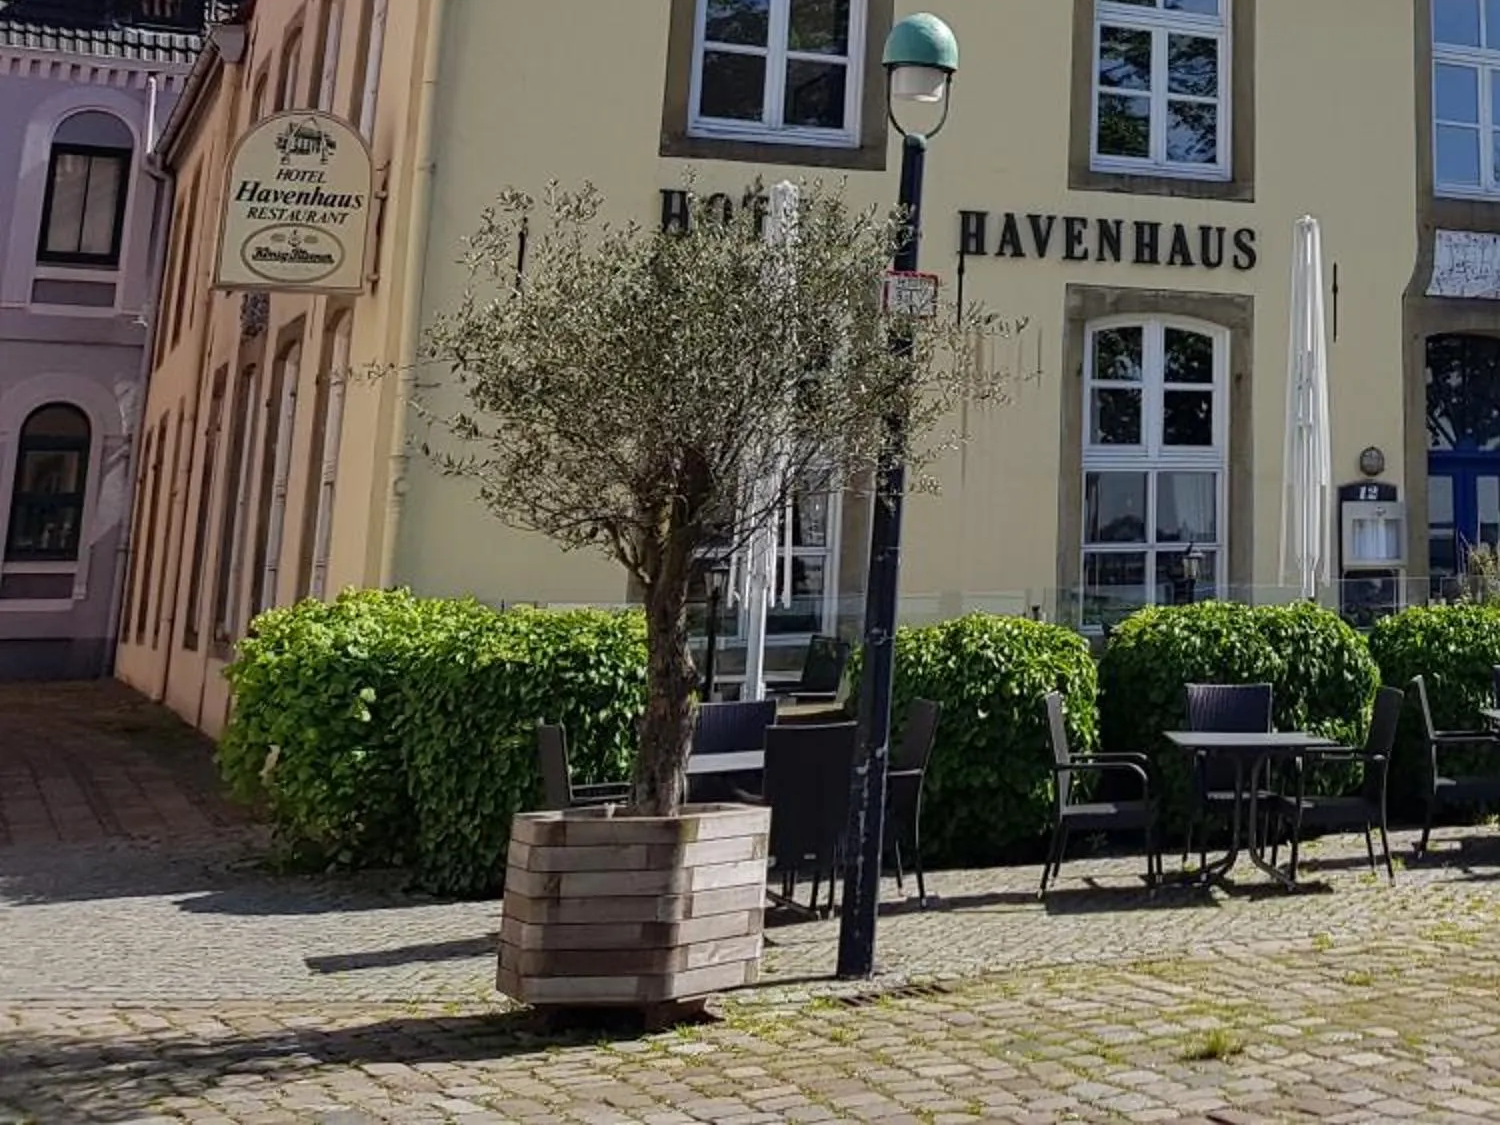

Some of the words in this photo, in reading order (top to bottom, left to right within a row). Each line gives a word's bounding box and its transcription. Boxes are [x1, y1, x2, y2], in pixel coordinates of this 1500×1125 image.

[276, 168, 327, 184] HOTEL
[234, 179, 364, 209] Havenhaus
[246, 206, 350, 225] RESTAURANT
[957, 209, 1257, 270] HAVENHAUS
